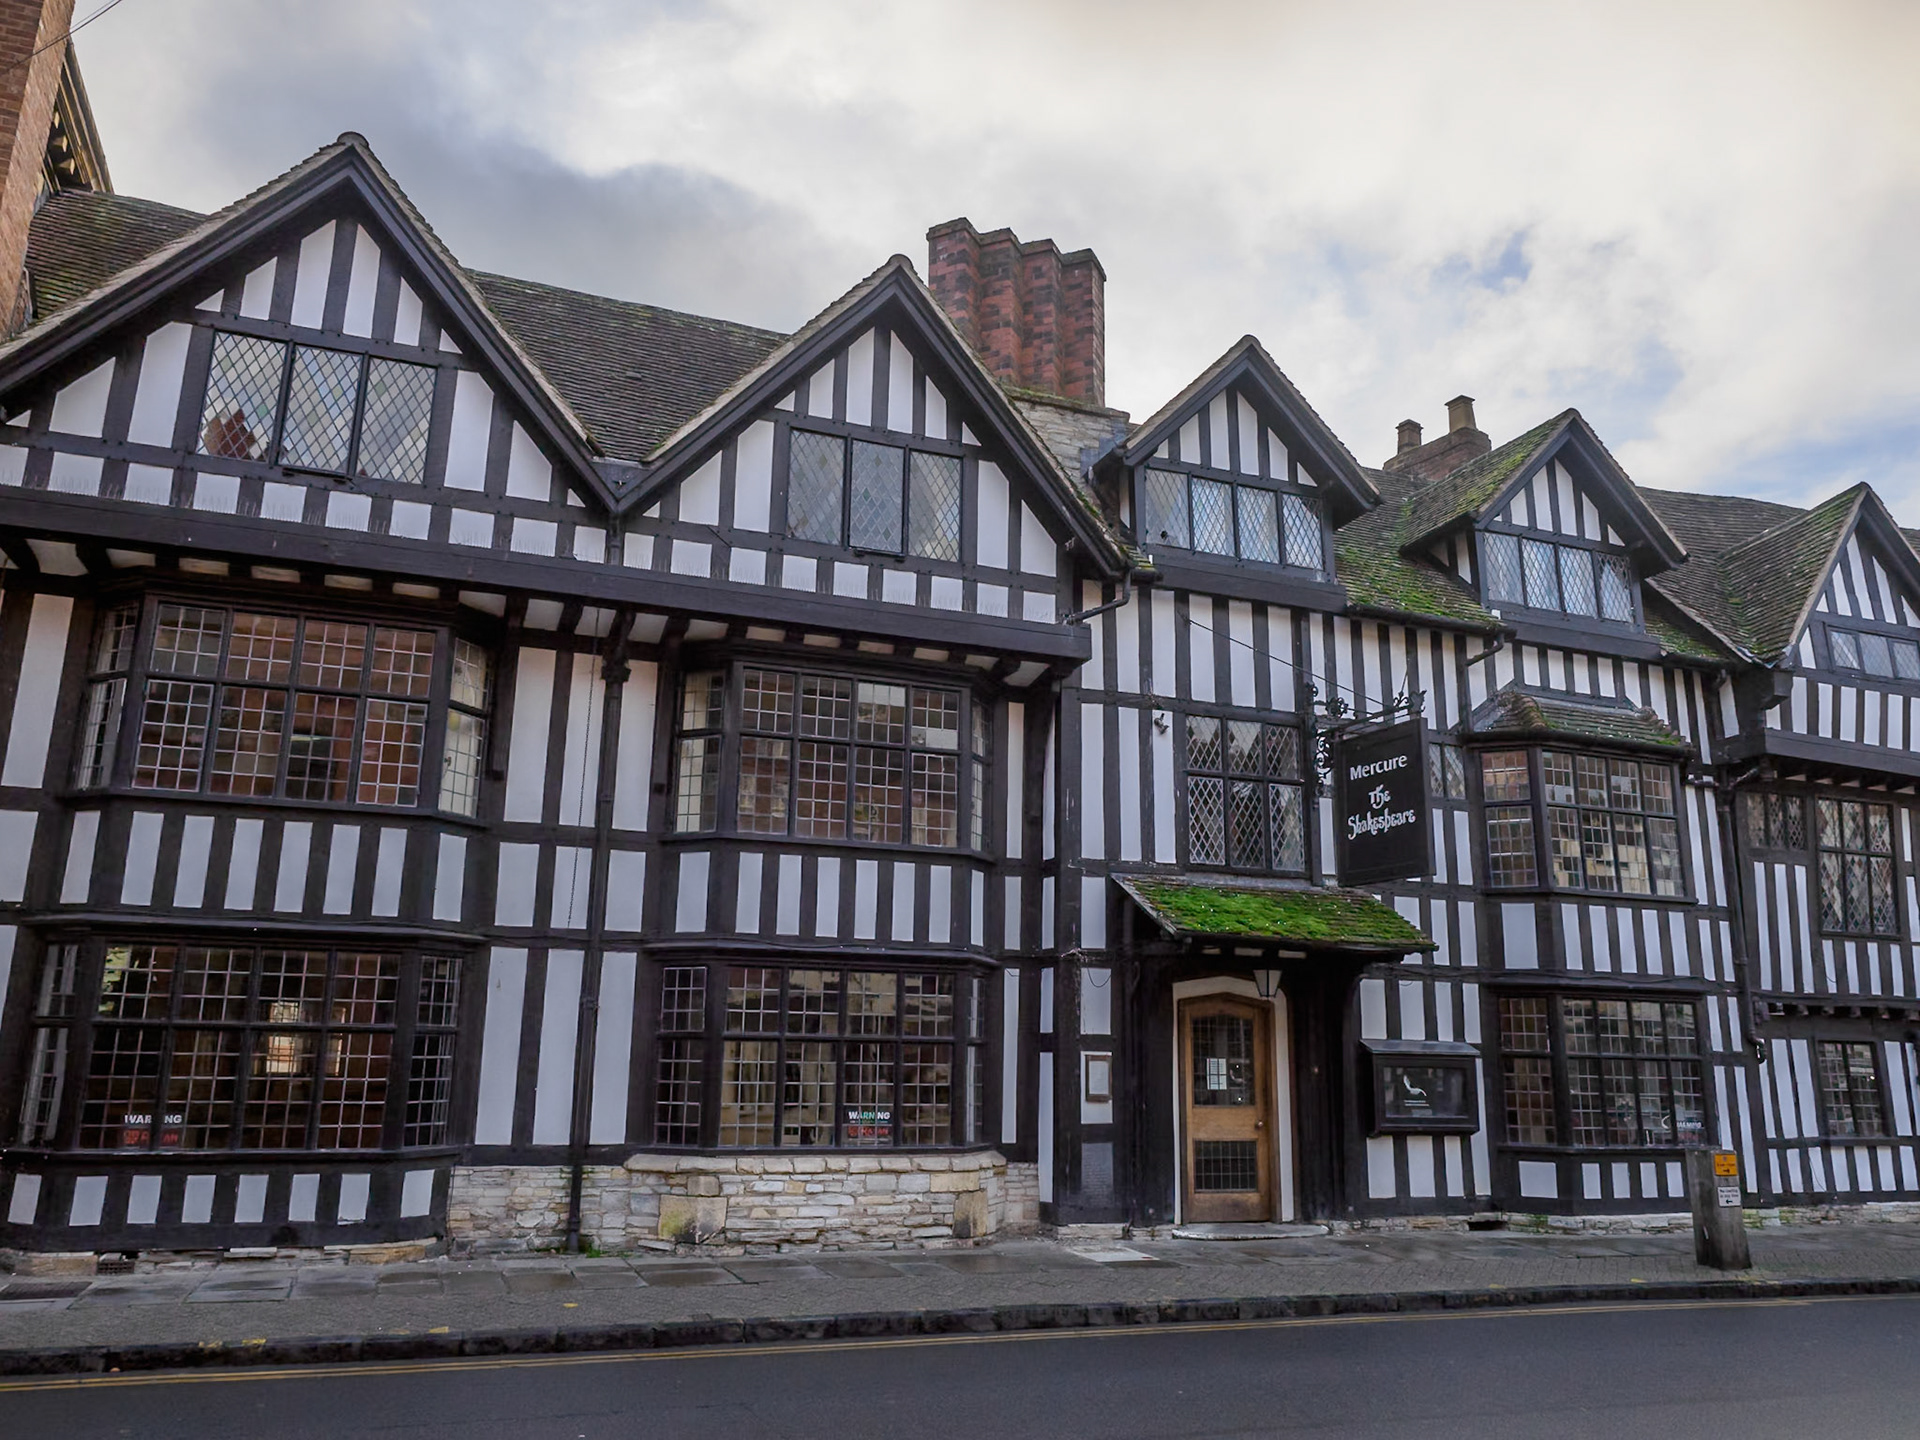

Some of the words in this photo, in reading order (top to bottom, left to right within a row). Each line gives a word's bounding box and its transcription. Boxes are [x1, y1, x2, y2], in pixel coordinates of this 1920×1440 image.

[1350, 754, 1408, 781] Mercure
[1368, 784, 1391, 809] The
[1347, 807, 1417, 840] Shakespeare
[124, 1114, 183, 1124] WARNG
